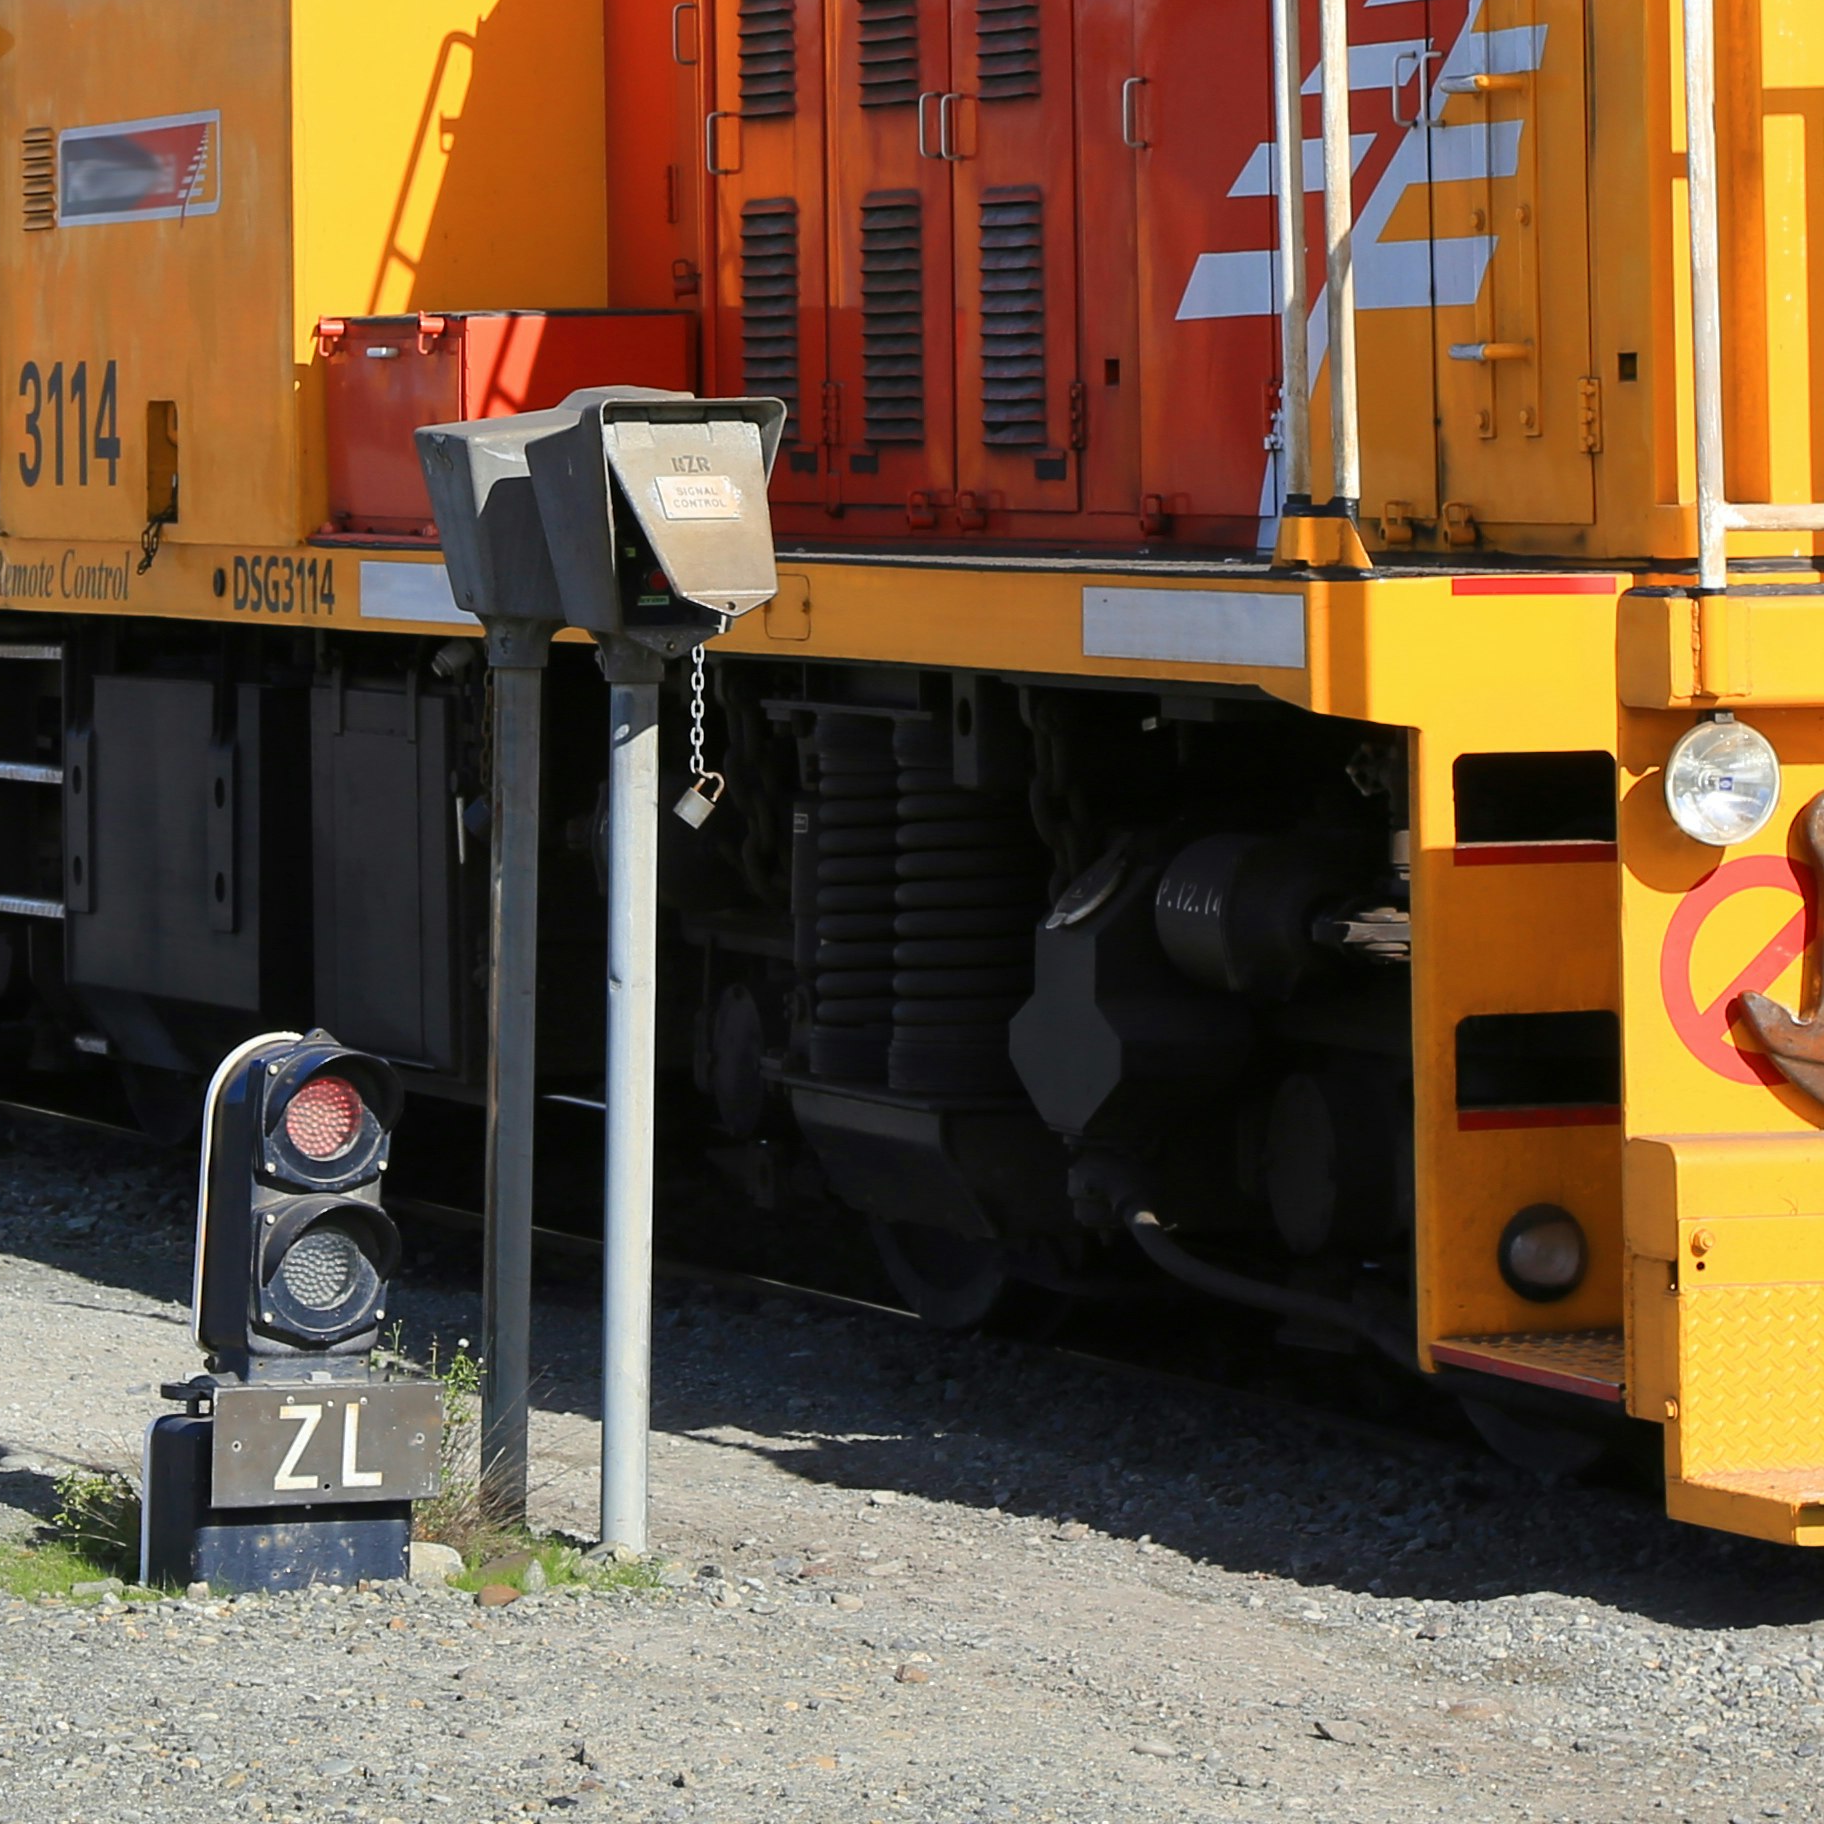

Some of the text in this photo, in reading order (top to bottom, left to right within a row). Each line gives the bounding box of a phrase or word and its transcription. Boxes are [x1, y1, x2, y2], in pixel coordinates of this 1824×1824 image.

[19, 360, 121, 488] 3114
[671, 454, 711, 474] NZR
[672, 499, 727, 509] CONTROL
[676, 486, 719, 497] SIGNAL
[61, 549, 130, 601] Control
[233, 555, 335, 615] DSG3114
[273, 1402, 383, 1492] ZL
